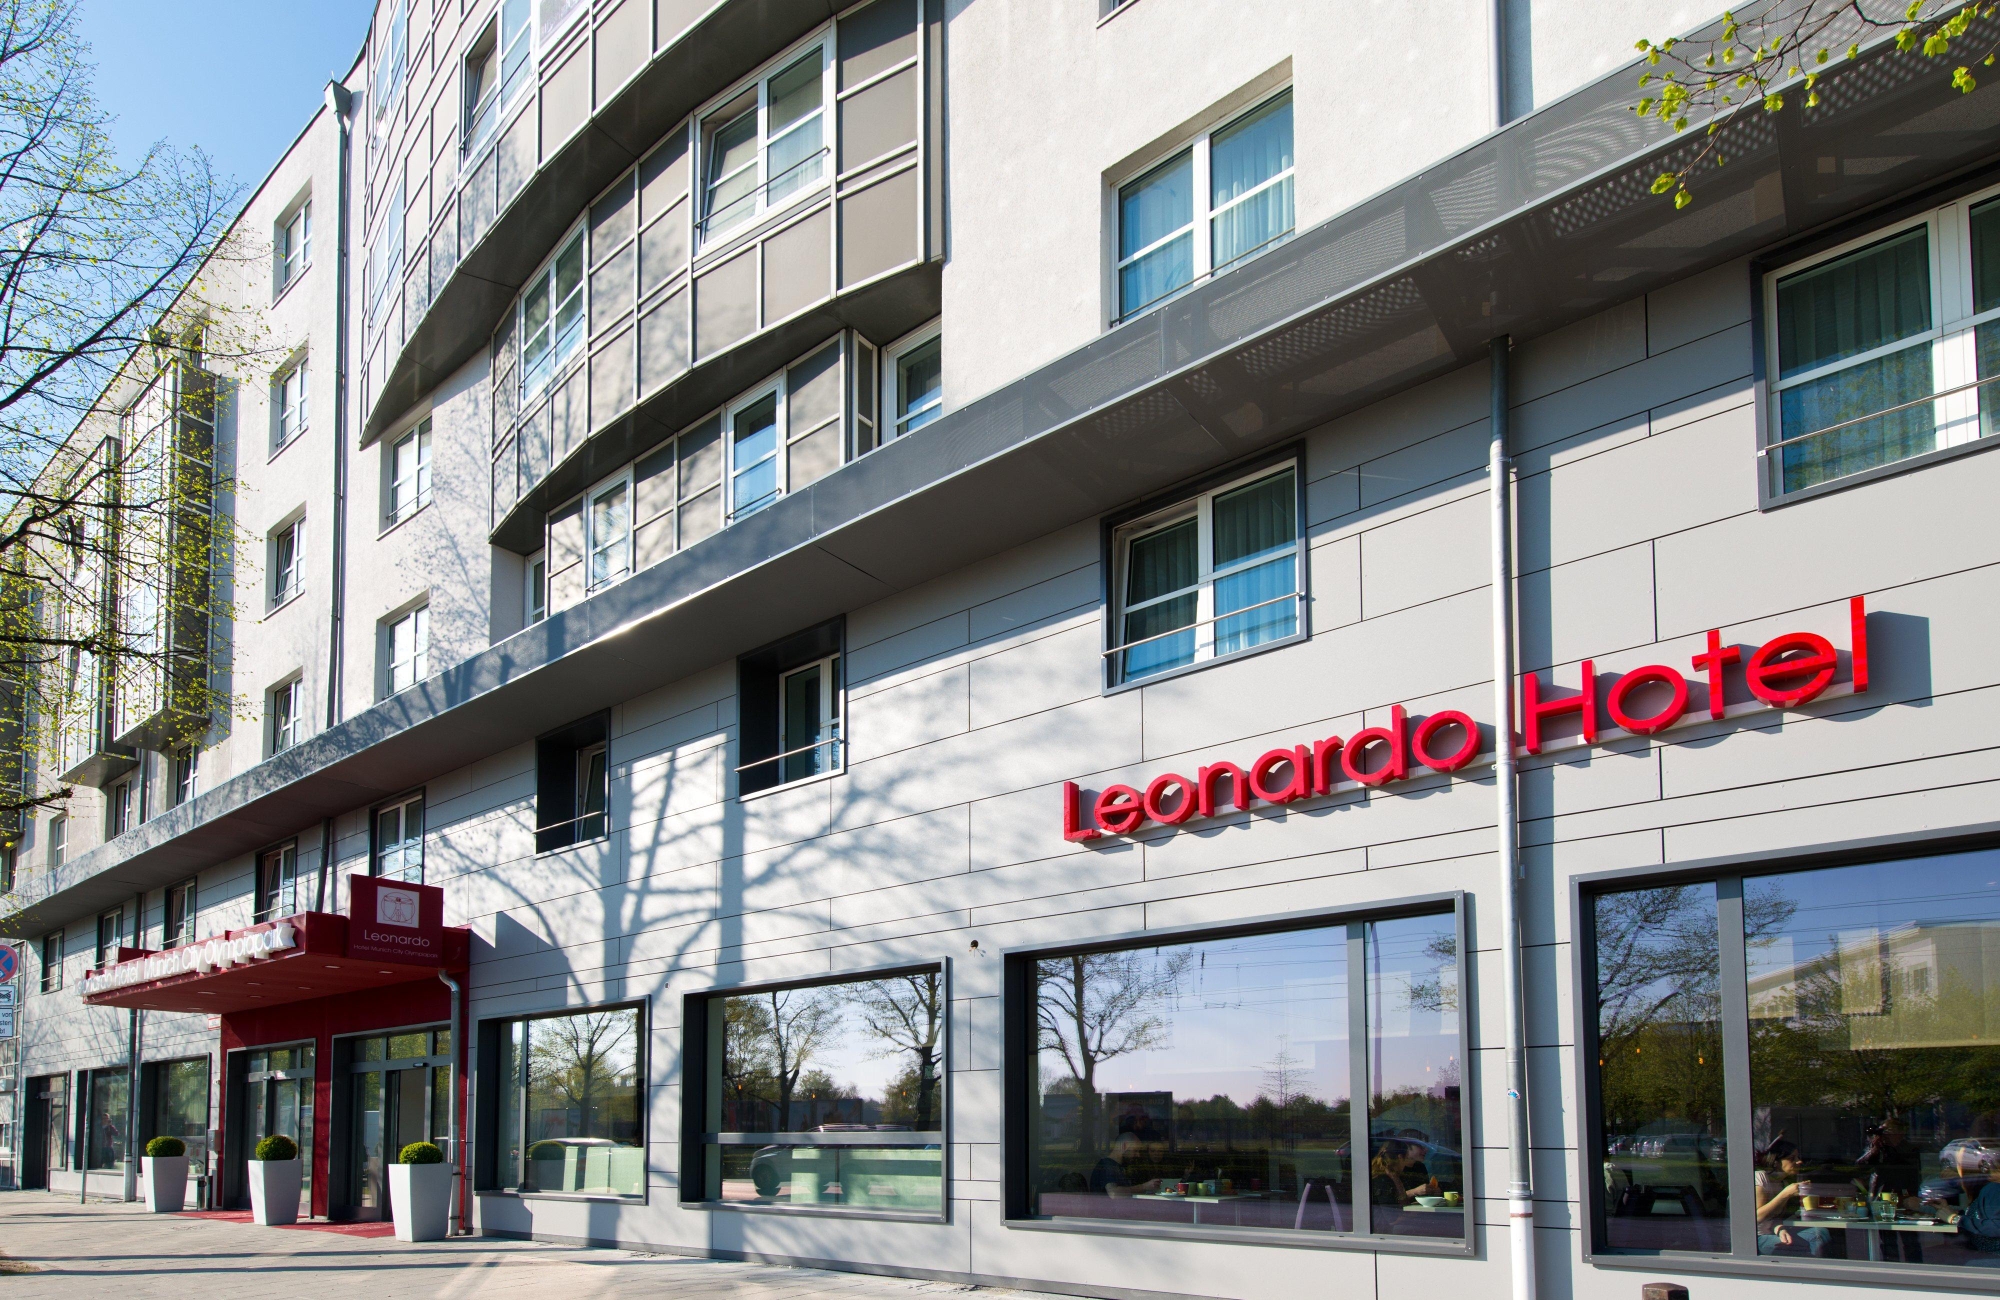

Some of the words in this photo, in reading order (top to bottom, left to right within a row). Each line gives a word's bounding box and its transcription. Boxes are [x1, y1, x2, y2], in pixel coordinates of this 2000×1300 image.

[1063, 704, 1482, 843] Leonardo
[1523, 595, 1868, 756] Hotel
[114, 961, 139, 986] Hotel
[144, 951, 180, 980] Munich
[182, 945, 205, 972] City
[205, 922, 292, 968] Olympiapark
[364, 929, 430, 947] Leonardo
[371, 945, 392, 953] Munich
